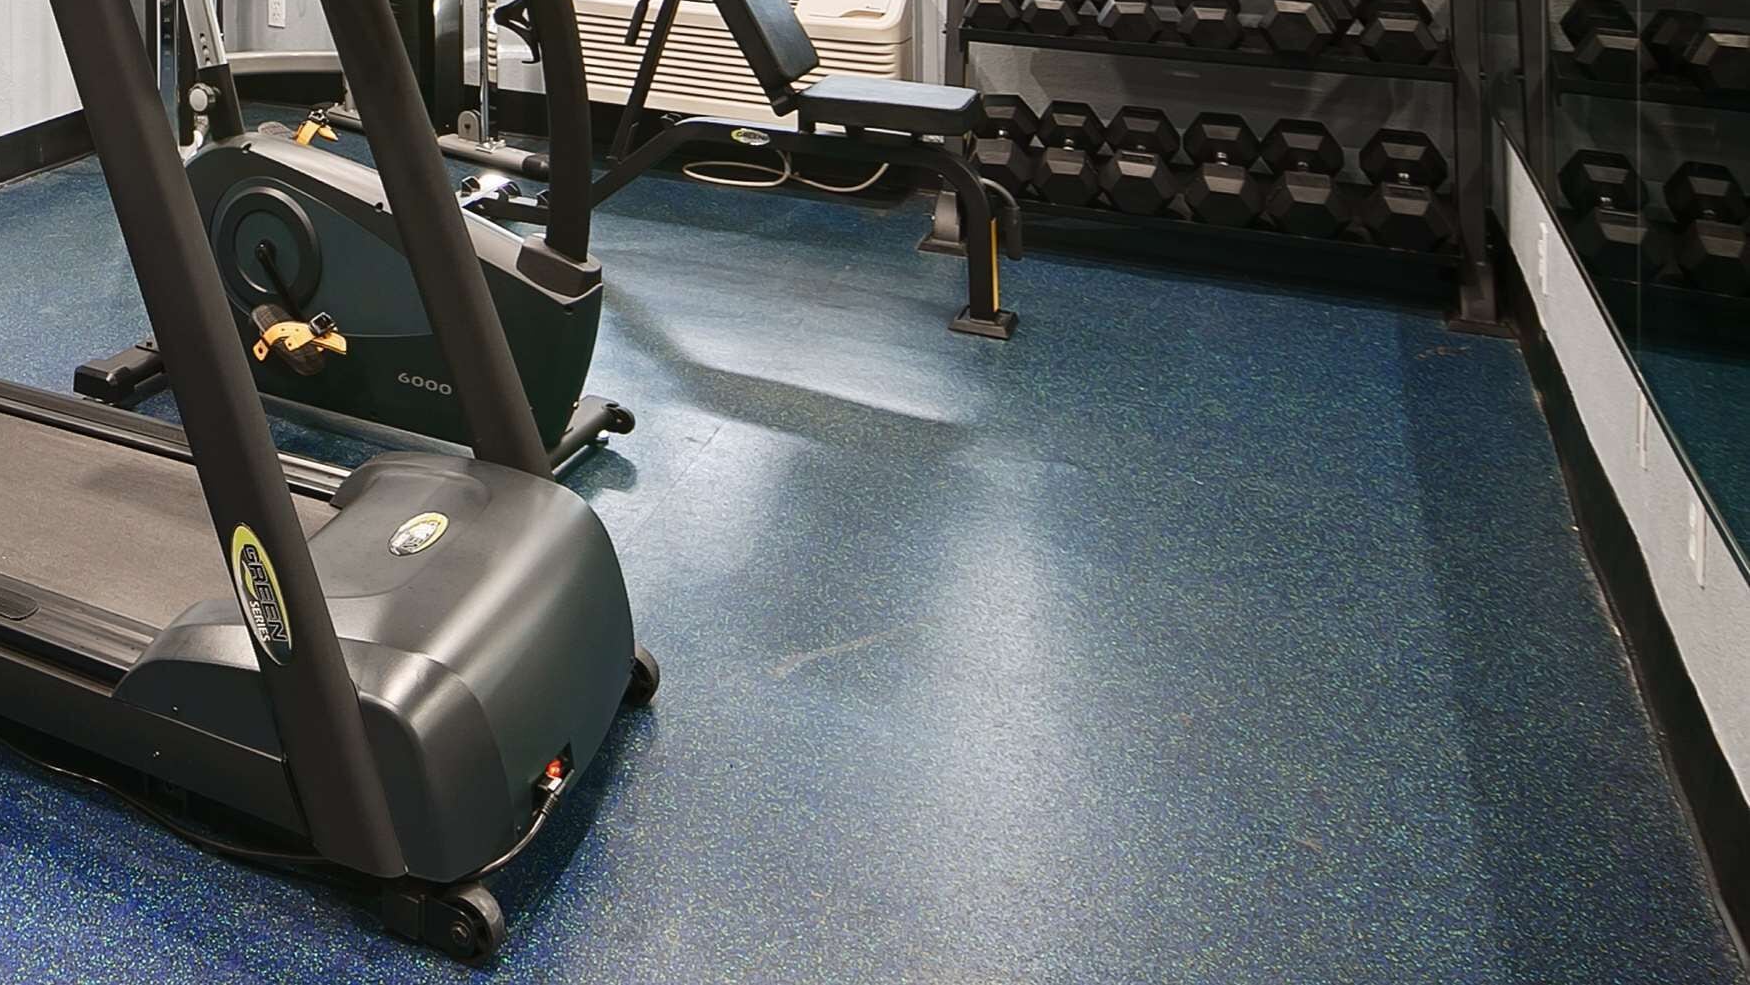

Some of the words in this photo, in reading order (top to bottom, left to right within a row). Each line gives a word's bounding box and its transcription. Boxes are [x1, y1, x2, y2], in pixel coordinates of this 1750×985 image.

[398, 372, 452, 395] 6000
[243, 544, 288, 642] GREEN
[249, 600, 271, 642] SERIES
